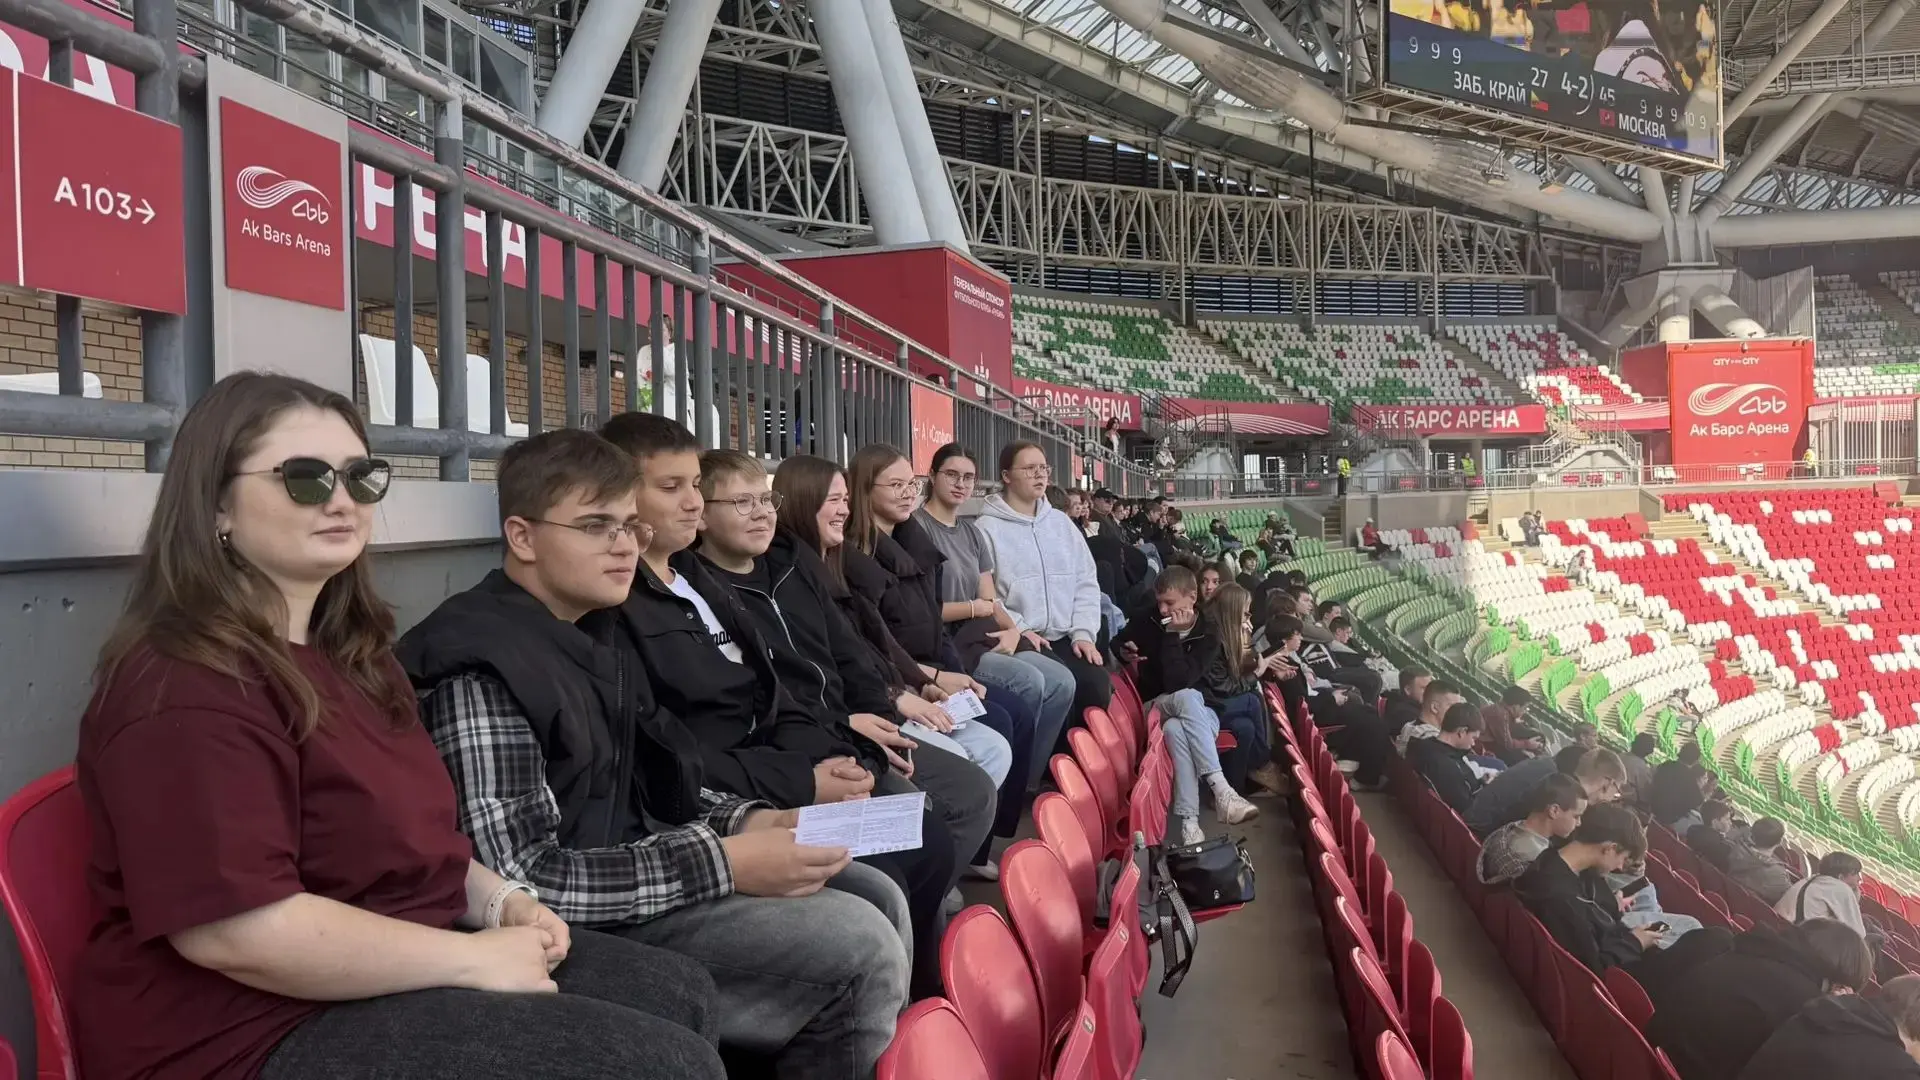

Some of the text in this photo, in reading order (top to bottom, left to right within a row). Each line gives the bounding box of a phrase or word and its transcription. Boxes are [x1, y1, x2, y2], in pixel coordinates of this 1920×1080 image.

[1408, 36, 1462, 65] 9 9 9
[1453, 71, 1526, 105] ЗАБ. КРАЙ
[1531, 67, 1549, 88] 27
[1599, 86, 1616, 107] 45
[1618, 112, 1667, 140] МОСКВА
[1640, 99, 1647, 114] 9
[1670, 107, 1678, 122] 9
[1684, 111, 1695, 127] 10
[1699, 115, 1707, 130] 9
[242, 218, 331, 256] Ak Bars Arena
[1084, 395, 1132, 424] ARENA
[1375, 410, 1521, 429] АК БАРС АРЕНА
[1689, 421, 1789, 437] Ак Барс Арена
